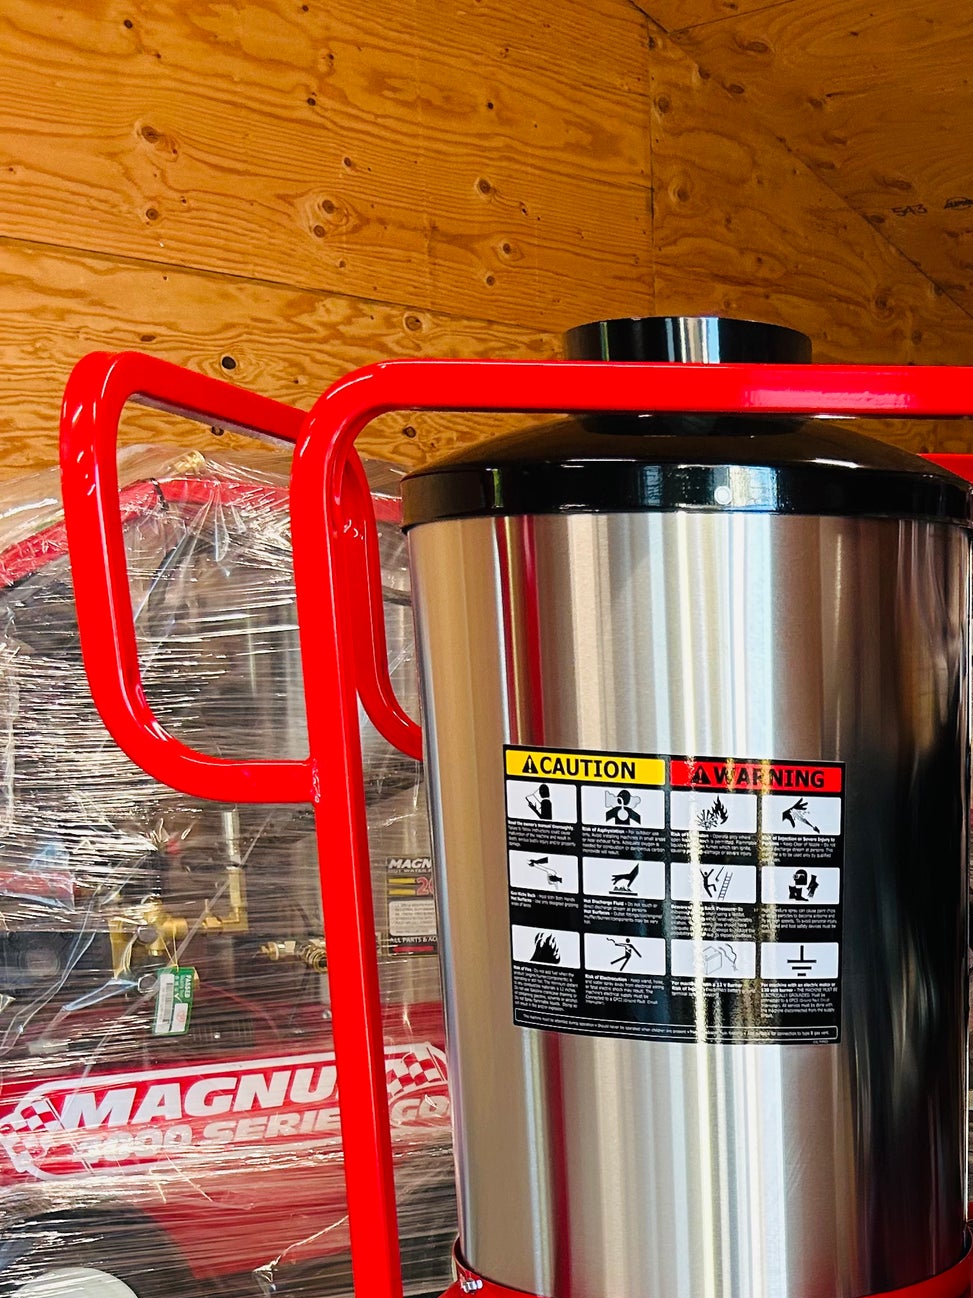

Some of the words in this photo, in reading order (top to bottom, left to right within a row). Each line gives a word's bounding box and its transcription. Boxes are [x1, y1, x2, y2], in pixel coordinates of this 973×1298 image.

[540, 757, 636, 779] CAUTION
[714, 765, 825, 788] WARNING
[389, 858, 431, 869] MAGN
[60, 1064, 340, 1131] MAGNU
[203, 1105, 342, 1146] SERIE
[391, 1094, 448, 1128] GO
